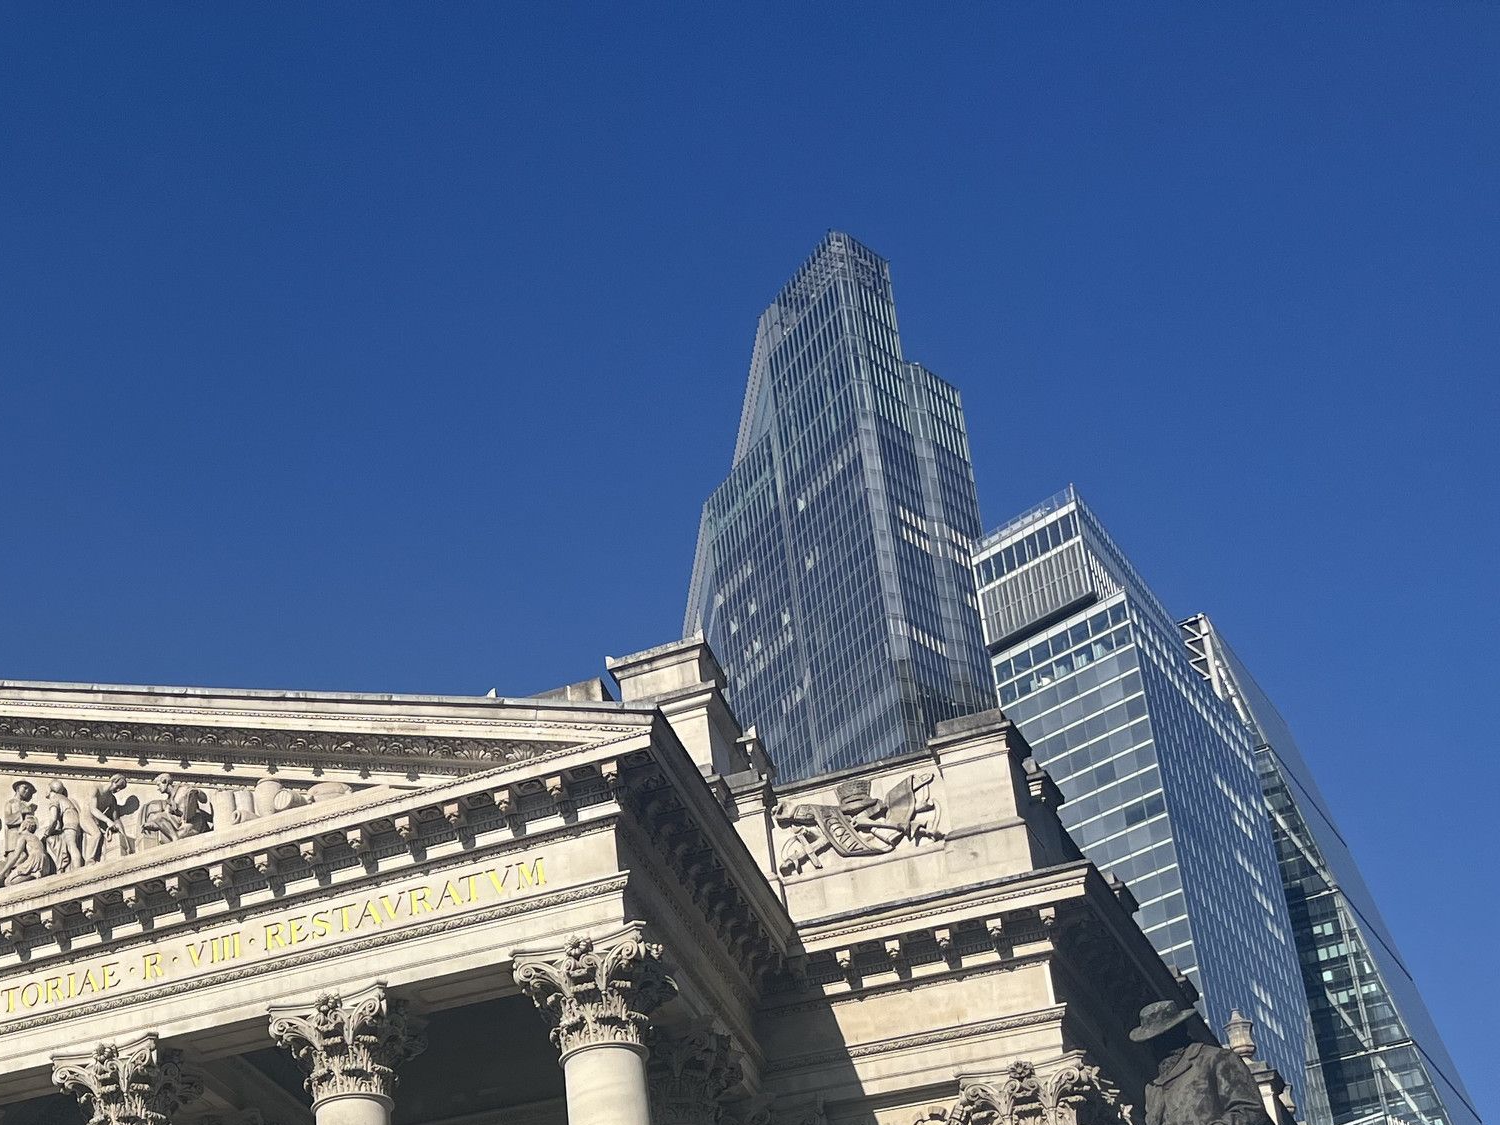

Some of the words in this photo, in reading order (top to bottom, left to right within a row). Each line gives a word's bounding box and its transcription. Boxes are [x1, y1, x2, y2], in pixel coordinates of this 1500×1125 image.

[142, 951, 164, 980] R
[186, 932, 242, 967] VIII
[263, 857, 548, 951] RESTAVRATVM
